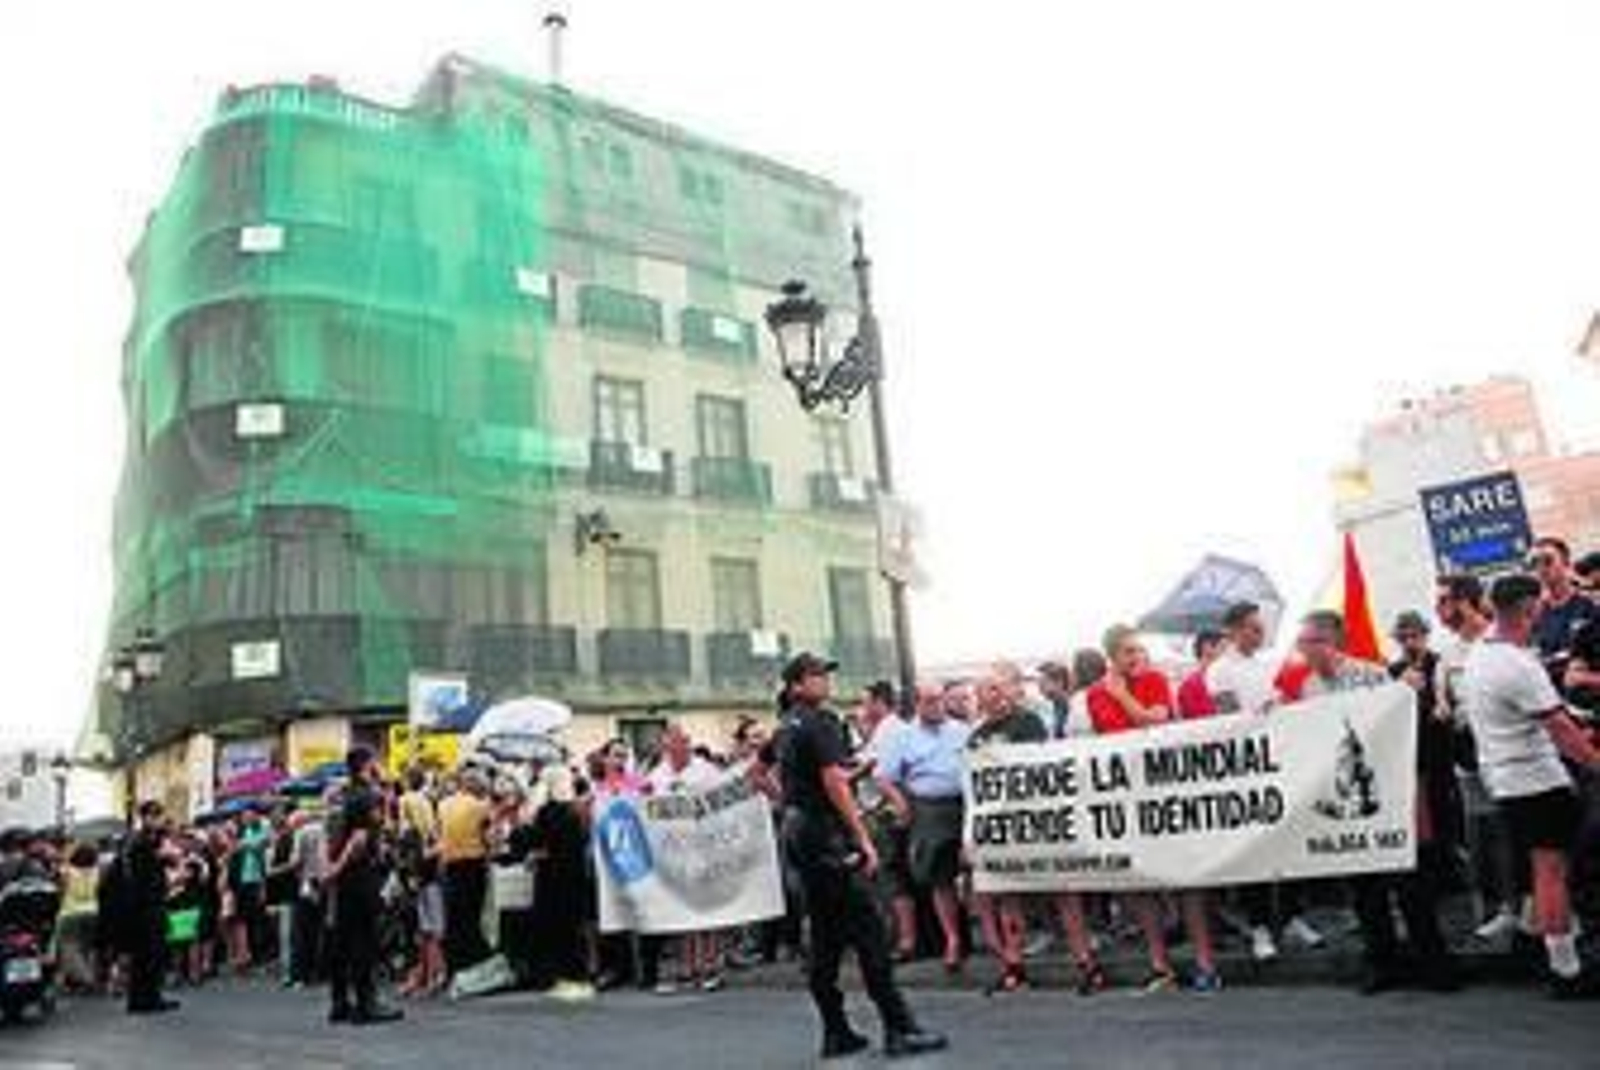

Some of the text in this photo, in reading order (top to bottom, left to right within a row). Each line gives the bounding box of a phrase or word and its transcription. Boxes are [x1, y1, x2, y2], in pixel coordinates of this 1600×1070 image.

[1091, 751, 1130, 792] LA
[1144, 734, 1279, 786] MUNDIAL
[1087, 800, 1126, 841] TU
[1138, 784, 1284, 835] IDENTIDAD
